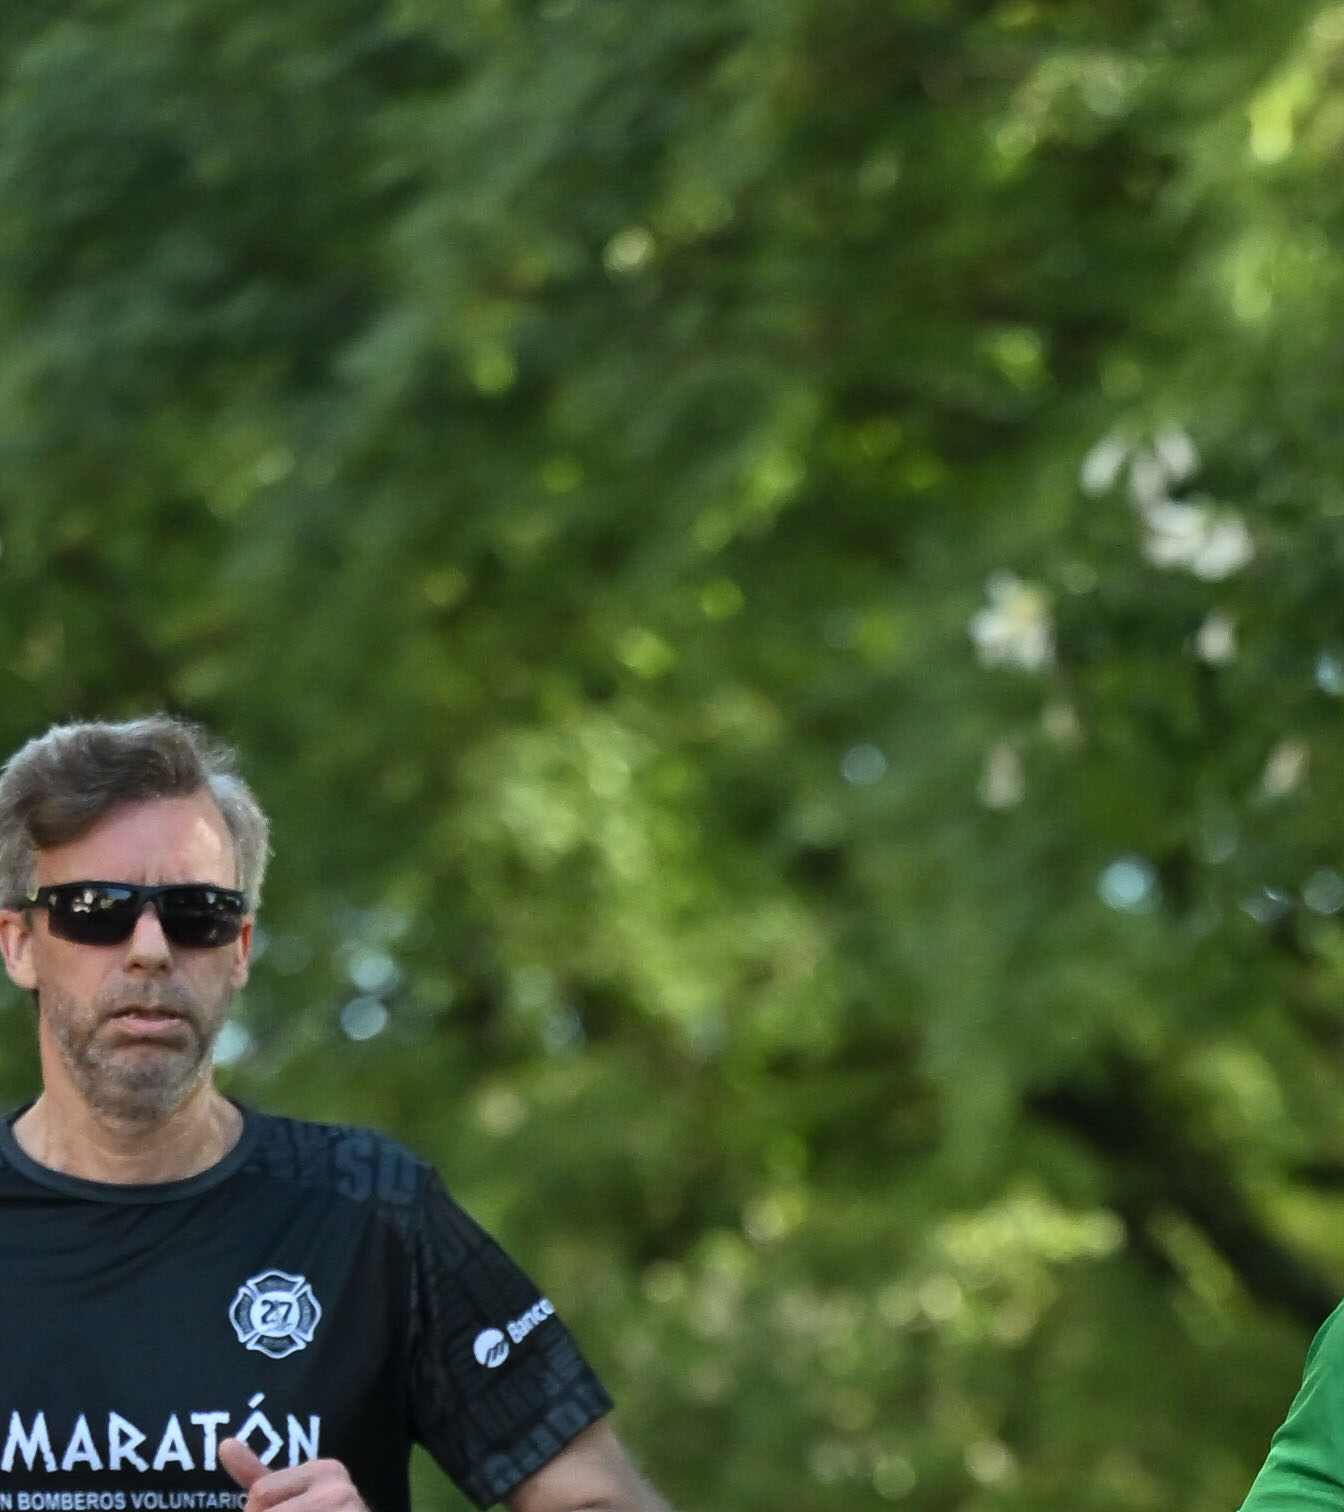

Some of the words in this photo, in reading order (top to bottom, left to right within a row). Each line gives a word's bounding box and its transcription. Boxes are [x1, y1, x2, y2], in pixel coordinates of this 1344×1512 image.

[261, 1299, 293, 1324] 27
[0, 1392, 320, 1472] MARATÓN
[18, 1491, 126, 1511] BOMBEROS
